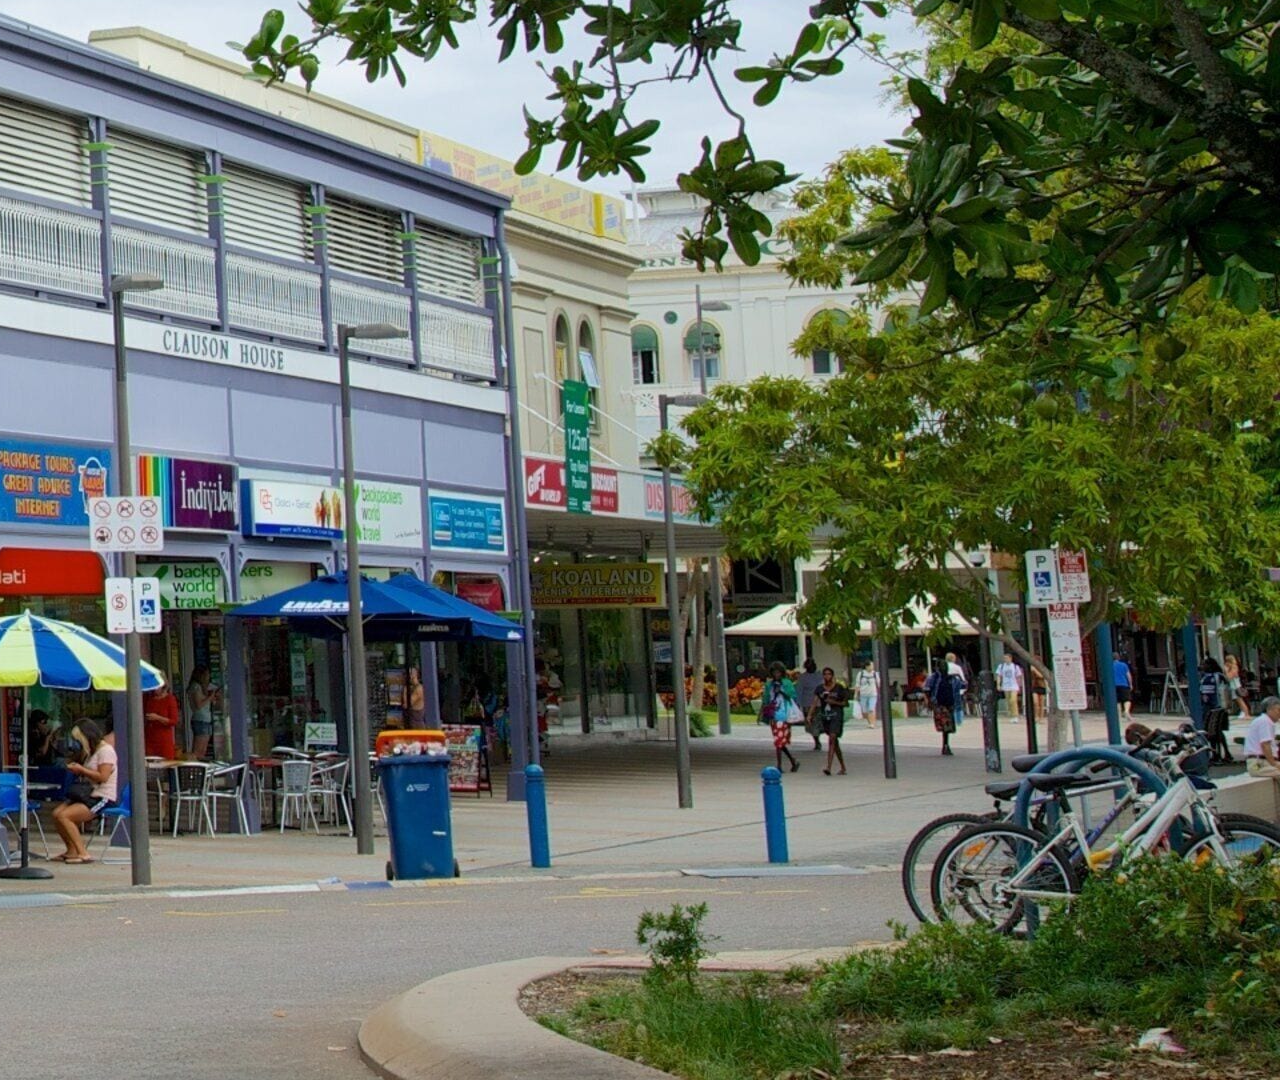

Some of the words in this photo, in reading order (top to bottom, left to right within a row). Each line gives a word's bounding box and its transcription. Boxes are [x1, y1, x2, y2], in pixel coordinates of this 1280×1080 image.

[162, 330, 229, 360] CLAUSON
[240, 343, 284, 370] HOUSE
[566, 400, 575, 414] For
[574, 403, 586, 415] Lease
[44, 455, 76, 473] TOURS
[2, 473, 33, 492] GREAT
[37, 477, 71, 495] ADVICE
[527, 464, 546, 497] GIFT
[361, 484, 403, 505] backpackers
[15, 498, 61, 517] INTERNET
[362, 506, 381, 522] world
[362, 526, 382, 542] travel
[1035, 555, 1046, 568] P
[552, 569, 653, 585] KOALAND
[173, 579, 216, 593] world
[579, 585, 655, 596] SUPERMARKET
[174, 593, 216, 608] travel
[1049, 611, 1076, 619] ZONE
